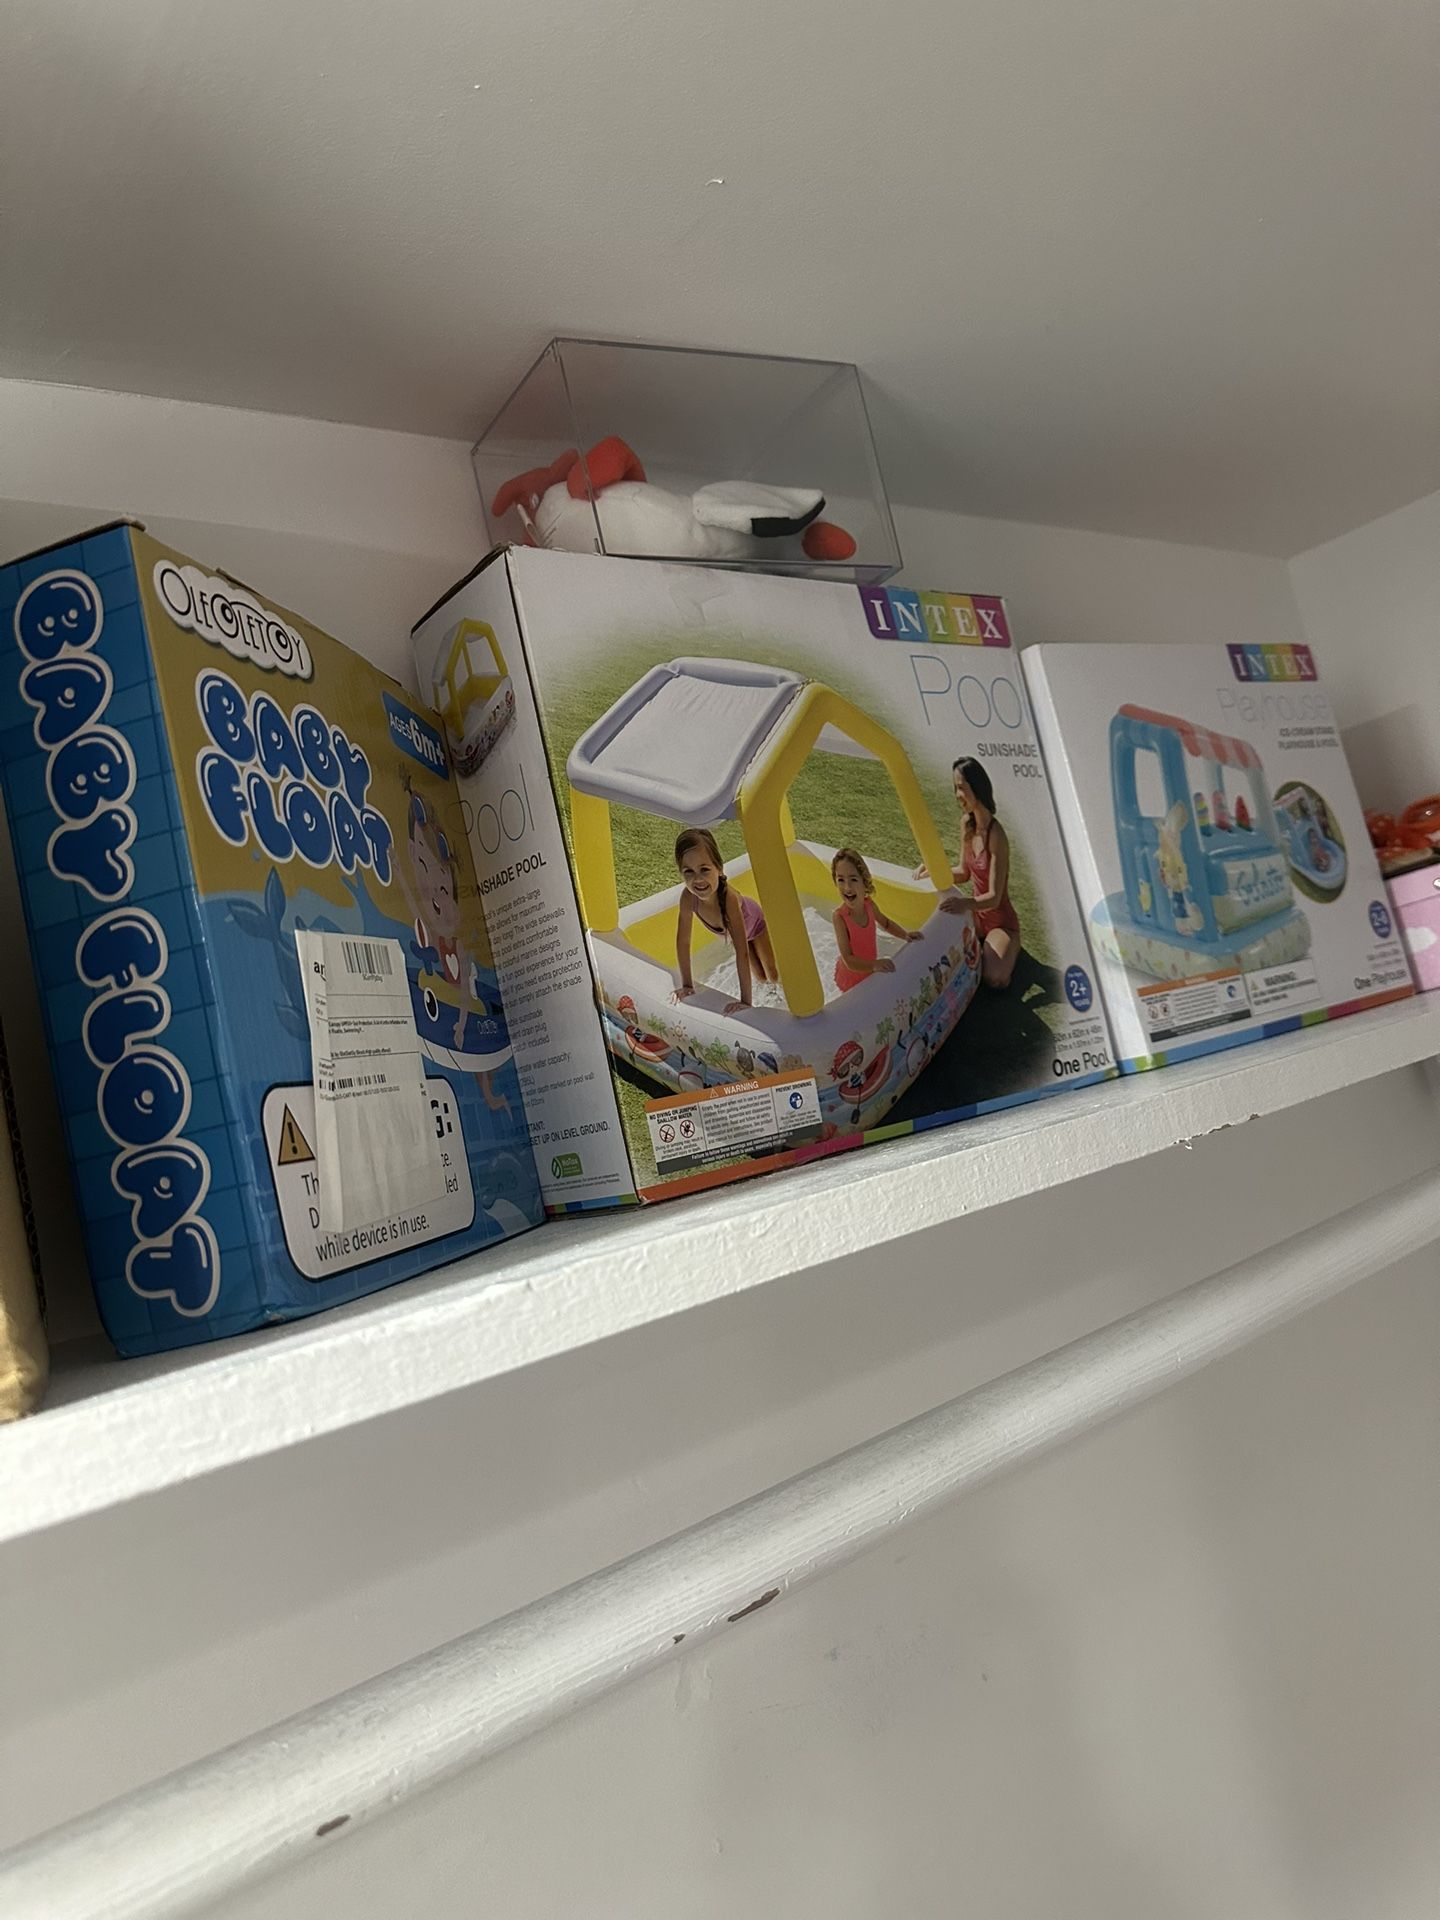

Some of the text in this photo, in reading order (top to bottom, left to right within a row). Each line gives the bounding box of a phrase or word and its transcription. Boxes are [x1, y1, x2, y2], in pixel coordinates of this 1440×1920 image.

[160, 567, 306, 671] OLEOLETOY
[870, 599, 1004, 639] INTEX
[1234, 653, 1313, 677] INTEX
[14, 568, 138, 902] BABY
[196, 667, 372, 808] BABY
[410, 718, 444, 766] 6m+
[976, 742, 1038, 758] SUNSHADE
[1012, 764, 1043, 778] POOL
[196, 747, 394, 887] FLOAT
[477, 852, 547, 897] NSHADE POOL
[1052, 1048, 1111, 1077] One Pool
[723, 1080, 759, 1095] WARNING
[75, 907, 220, 1317] FLOAT
[541, 1134, 551, 1144] UP
[551, 1131, 560, 1142] ON
[561, 1127, 580, 1140] LEVEL
[579, 1120, 611, 1136] GROUND.
[316, 1213, 430, 1262] while device is in use.
